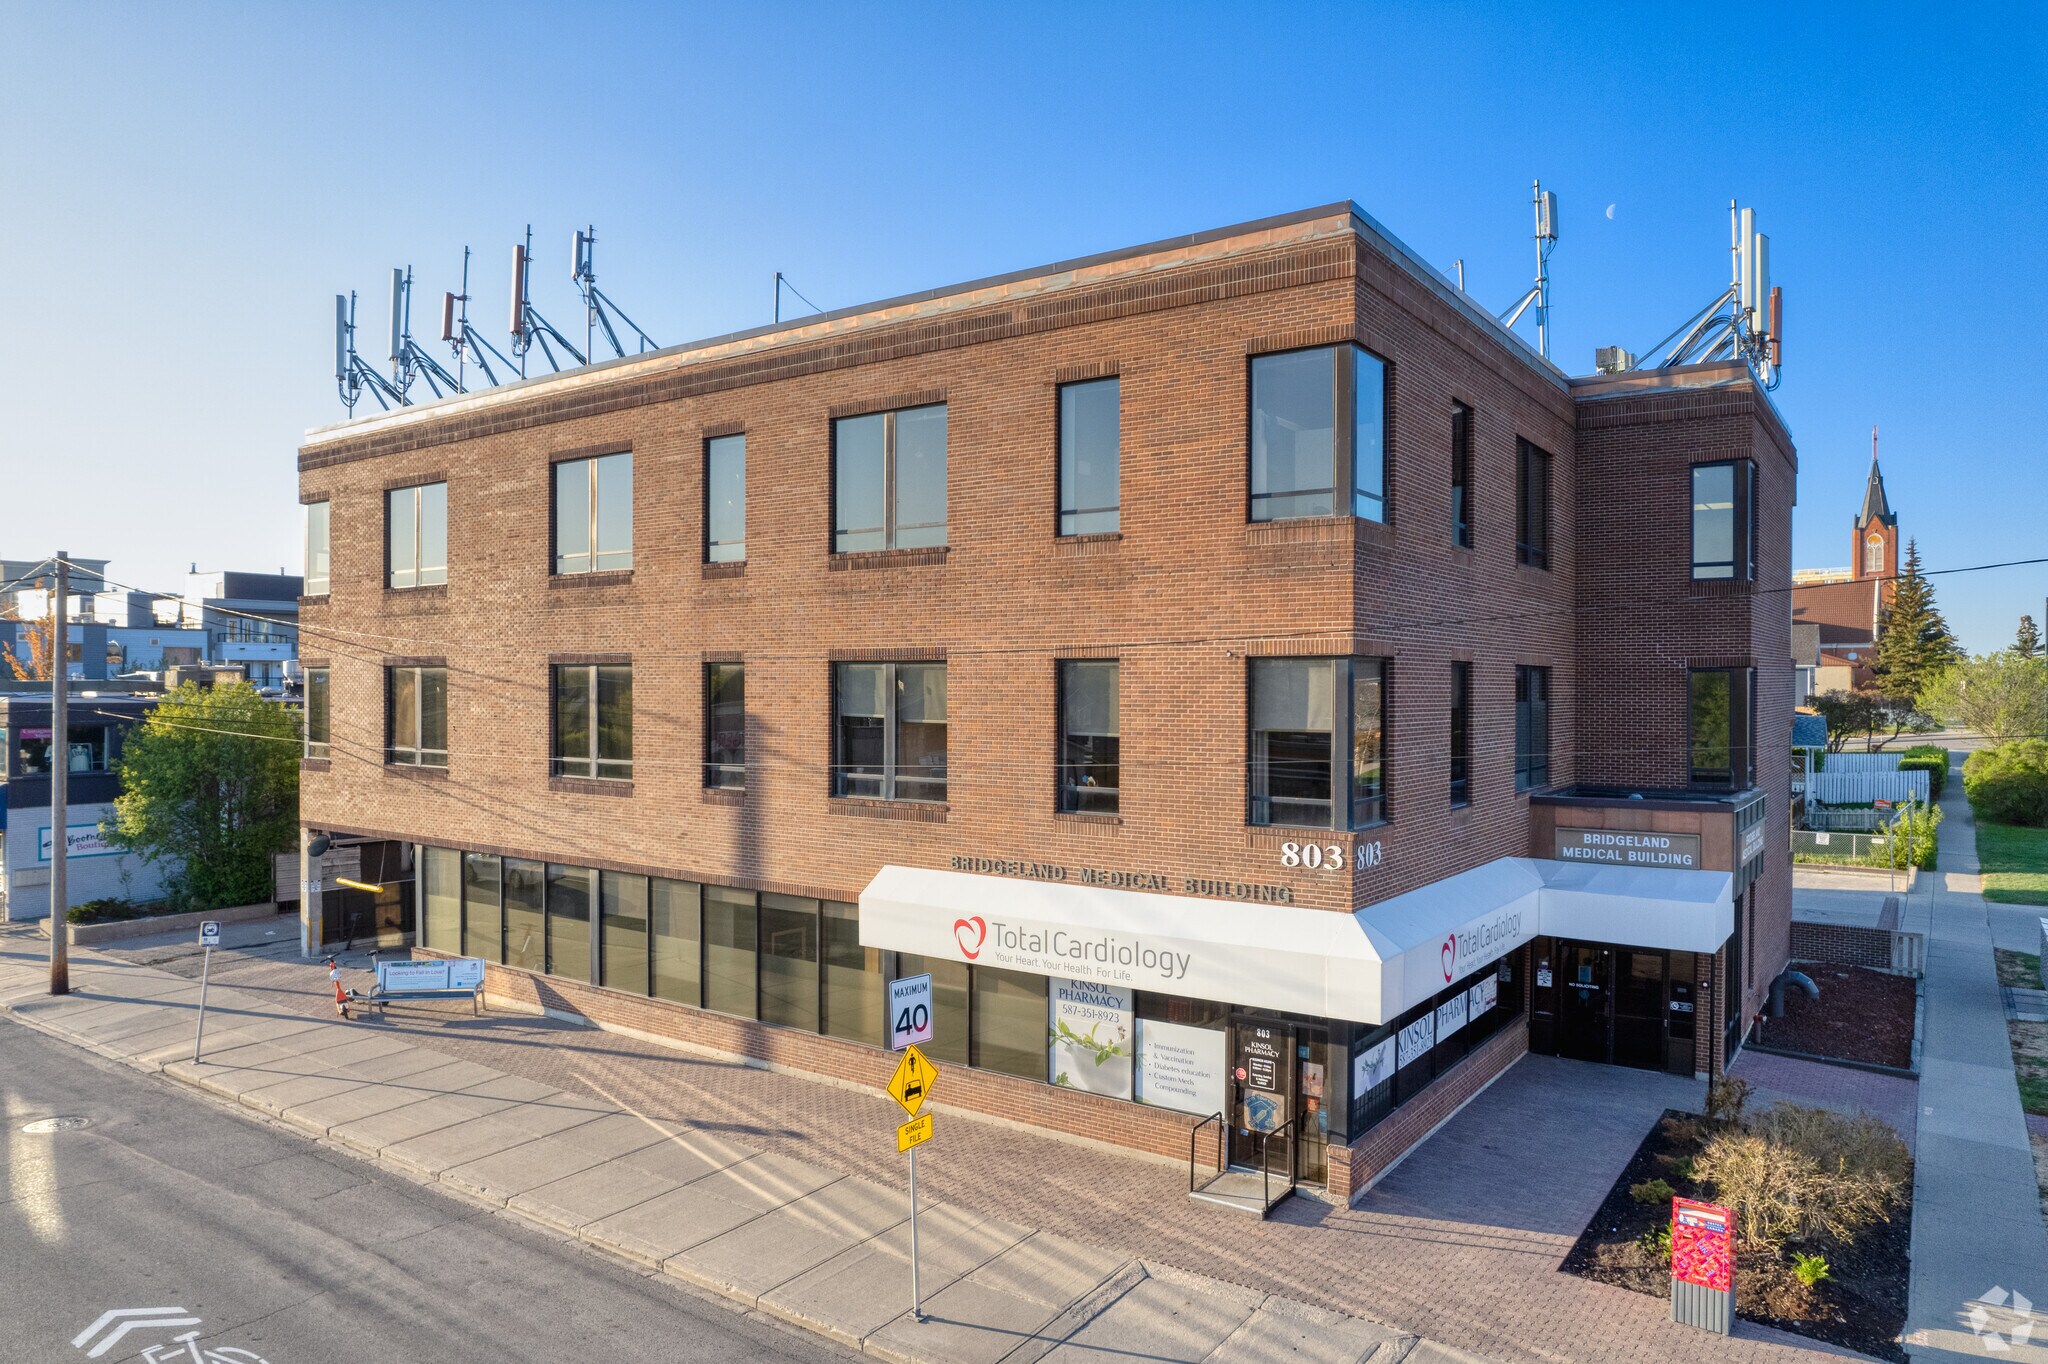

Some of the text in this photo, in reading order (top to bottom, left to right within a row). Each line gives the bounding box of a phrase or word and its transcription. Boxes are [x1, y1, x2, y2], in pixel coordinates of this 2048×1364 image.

[1583, 833, 1670, 849] BRIDGELAND
[1281, 842, 1343, 870] 803
[1357, 841, 1382, 870] 803
[1562, 846, 1692, 865] MEDICAL BUILDING
[950, 855, 1291, 903] BRIDGELAND MEDICAL BUILDING
[995, 951, 1134, 982] Your Heart. Your Health For Life.
[894, 982, 928, 999] MAXIMUM
[1071, 979, 1112, 996] KINSOL
[1059, 988, 1124, 1009] PHARMACY
[895, 1003, 929, 1036] 40
[1062, 1004, 1120, 1024] 587-351-8923
[1256, 1028, 1270, 1039] 803
[1154, 1042, 1195, 1056] Immunization
[1244, 1046, 1280, 1058] PHARMACY
[1251, 1041, 1274, 1051] KINSOL
[1160, 1053, 1194, 1066] Vaccination
[1153, 1072, 1195, 1086] Custom Meds
[1154, 1062, 1211, 1079] Diabetes education
[1154, 1082, 1197, 1097] Compounding
[904, 1119, 926, 1136] SINGLE
[909, 1131, 922, 1145] FILE
